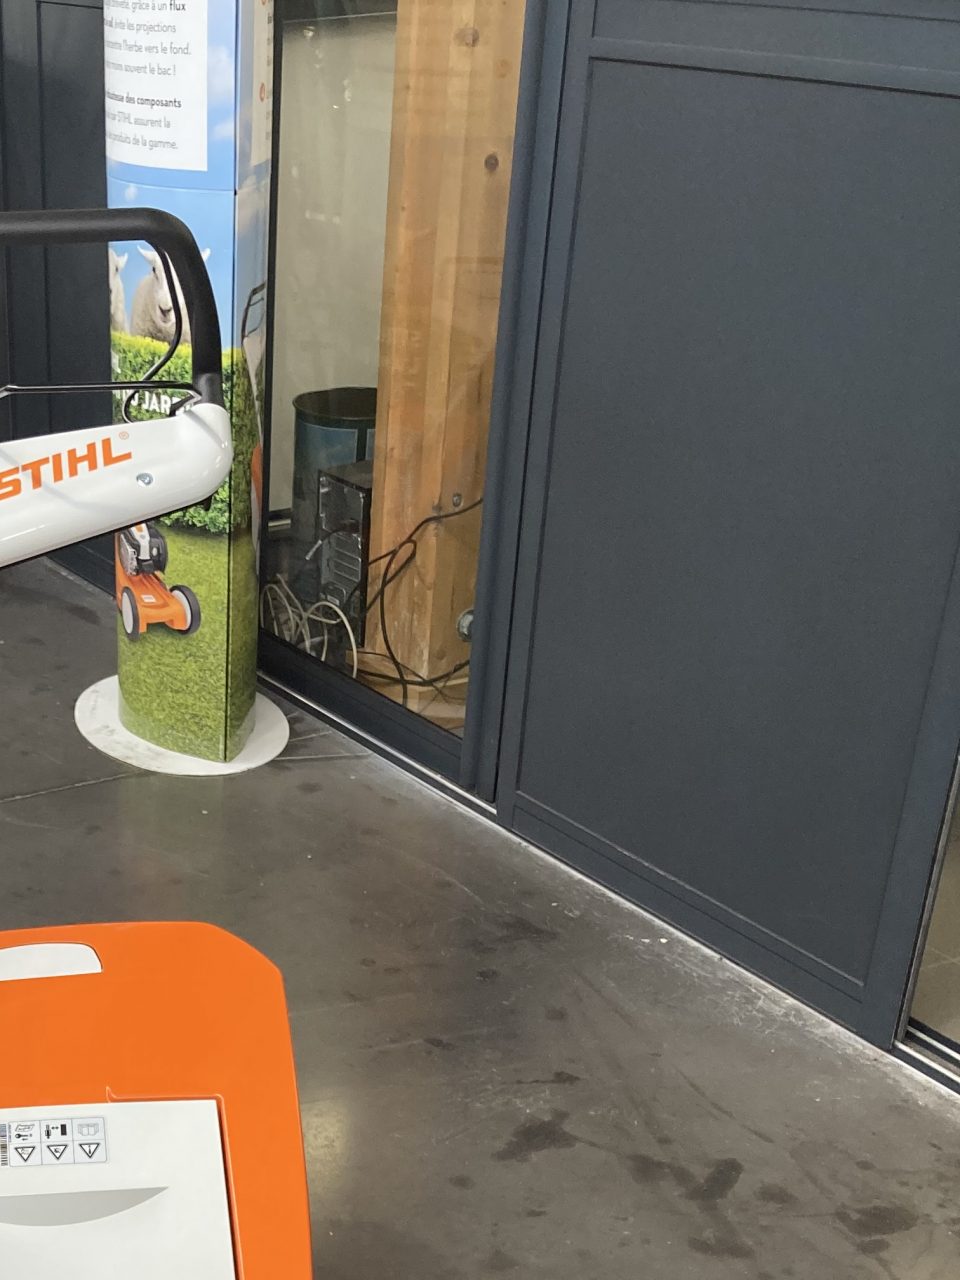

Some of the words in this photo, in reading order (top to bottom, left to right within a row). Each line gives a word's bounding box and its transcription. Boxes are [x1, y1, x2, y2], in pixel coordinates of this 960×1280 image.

[158, 2, 168, 11] un
[169, 0, 186, 11] flux
[136, 21, 177, 35] projections
[161, 41, 168, 54] le
[148, 62, 155, 75] le
[157, 62, 171, 75] bac
[136, 97, 182, 109] composants
